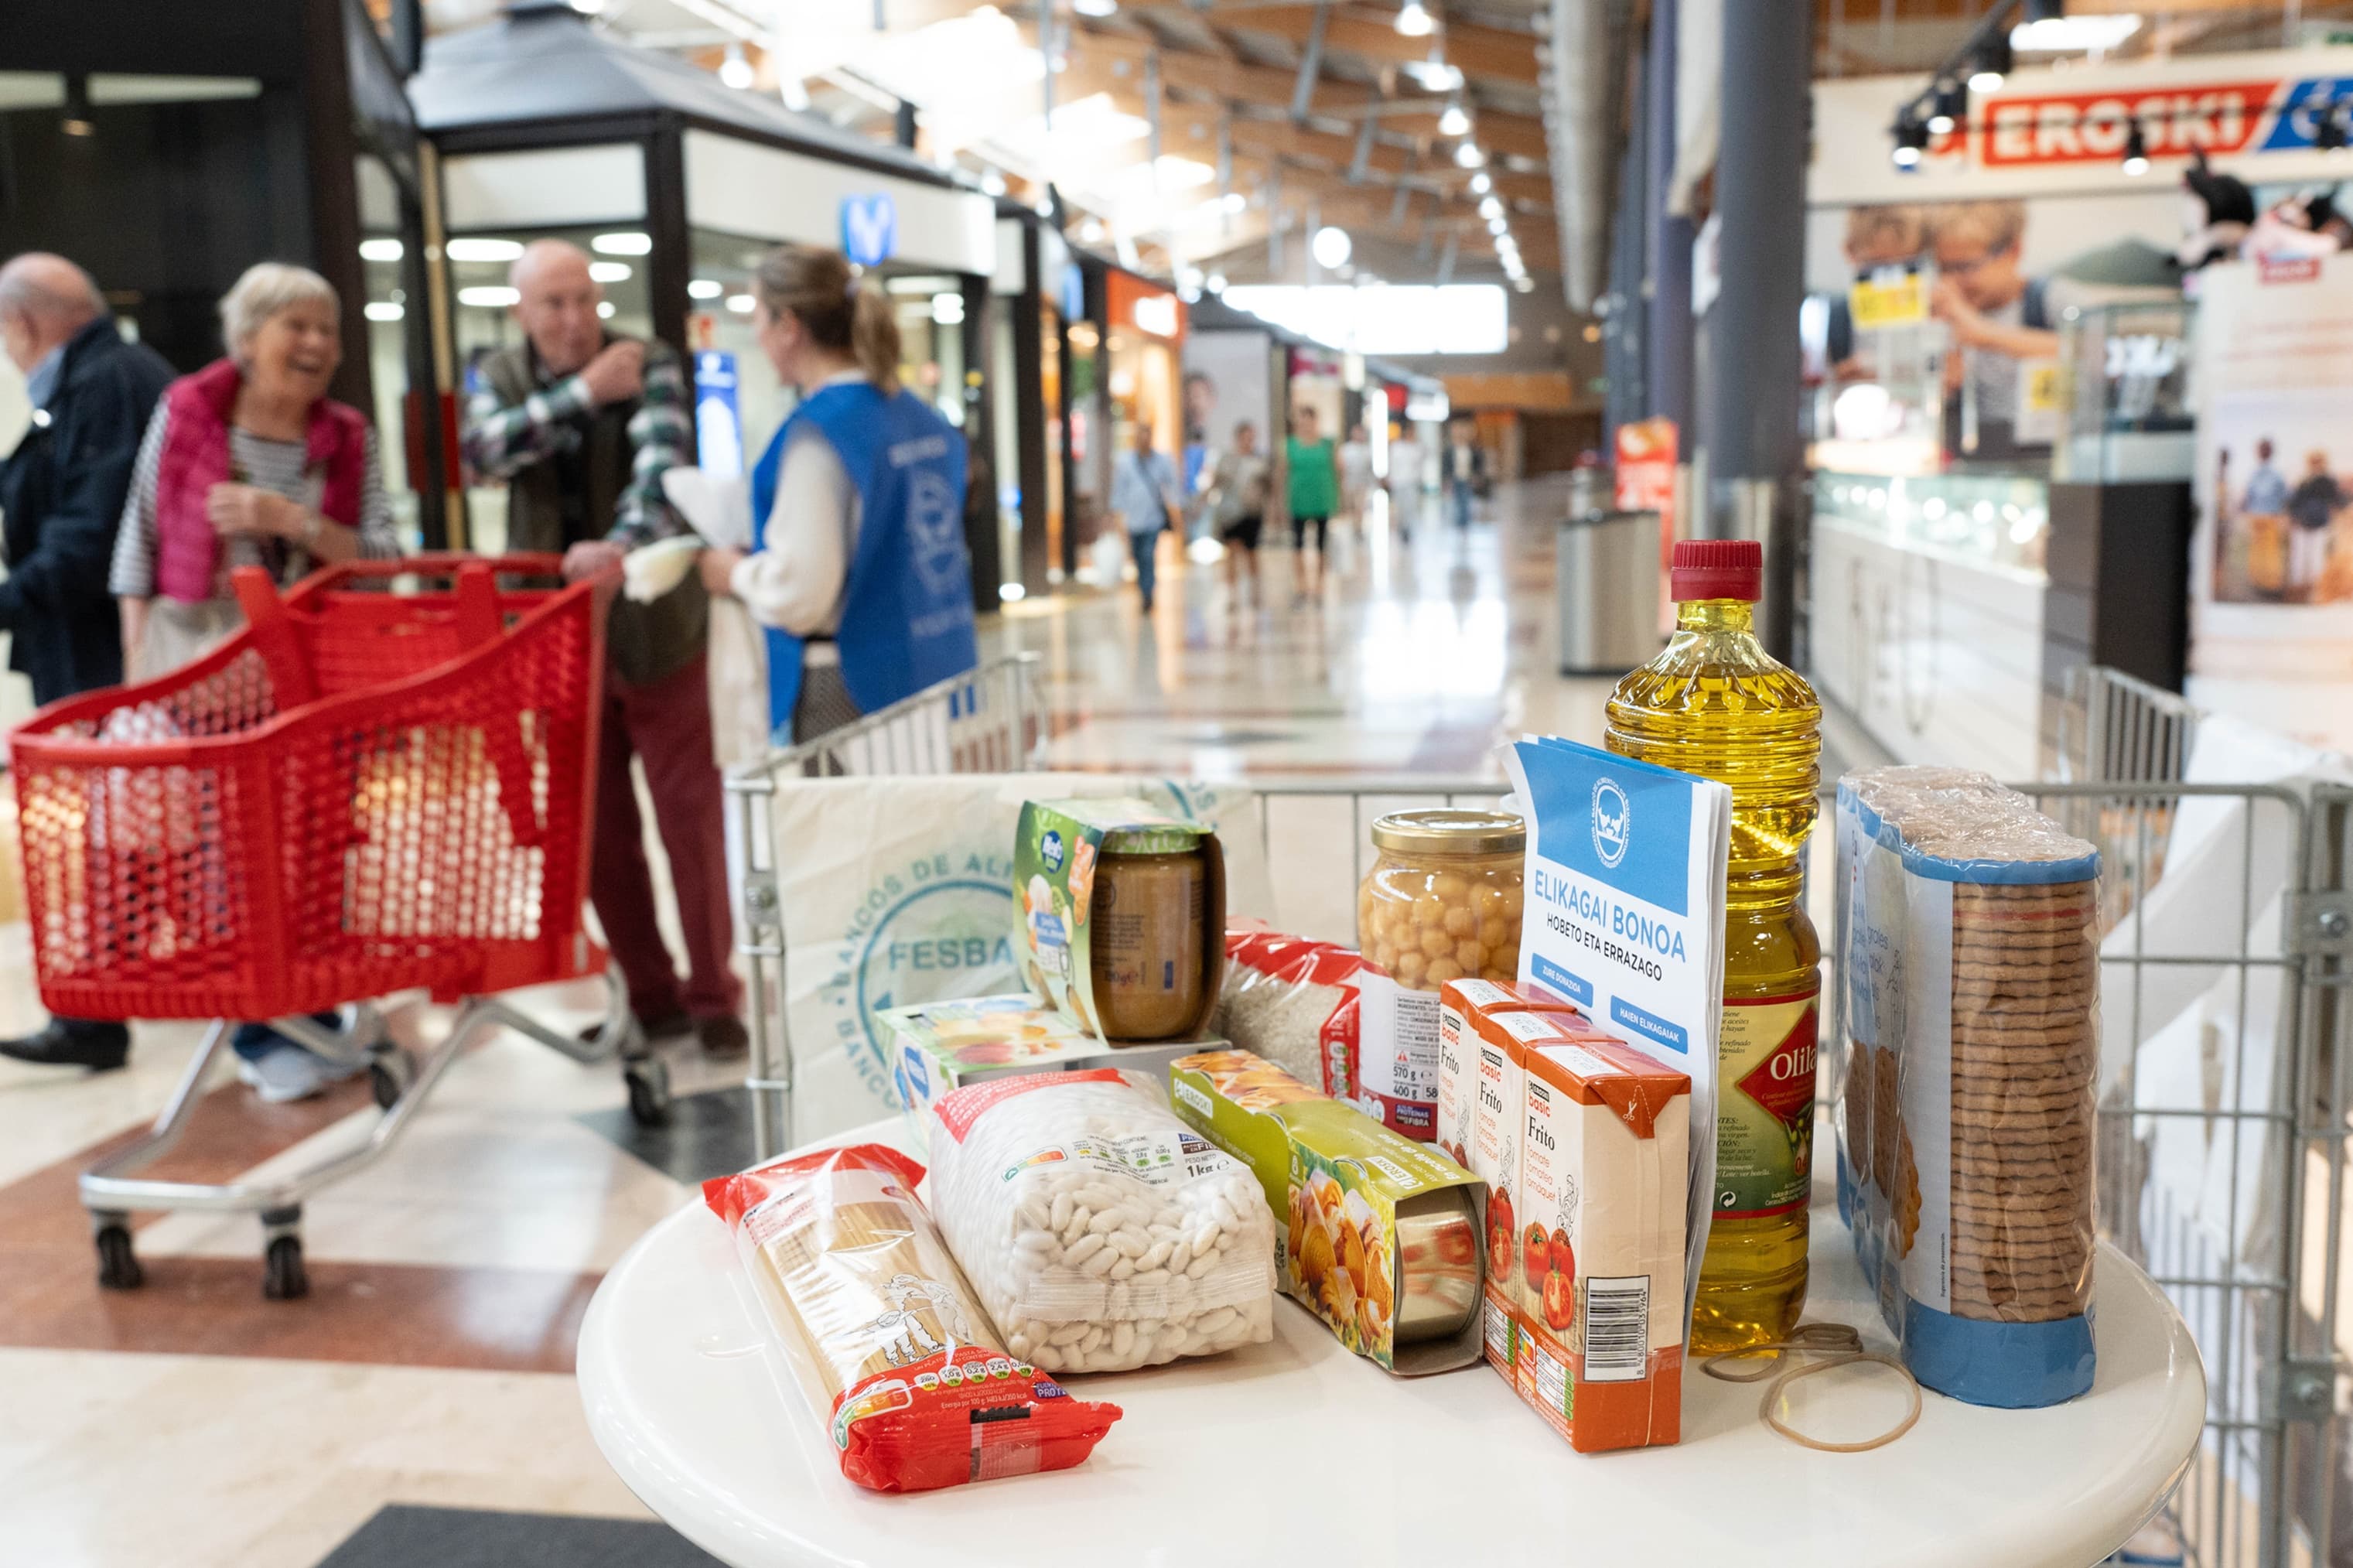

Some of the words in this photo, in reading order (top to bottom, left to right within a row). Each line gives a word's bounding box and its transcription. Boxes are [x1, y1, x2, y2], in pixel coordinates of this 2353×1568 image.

[1993, 91, 2245, 158] EROSKI
[912, 854, 950, 881] DE
[1535, 869, 1607, 928] ELIKAGAI
[1613, 904, 1686, 963] BONOA
[890, 937, 1014, 971] FESBA
[1547, 912, 1582, 943] HOBETO
[1584, 931, 1601, 953] ETA
[1603, 941, 1662, 982] ERRAZAGO
[1542, 965, 1556, 980] ZURE
[1556, 971, 1581, 994] DONAZIOA
[1441, 1023, 1460, 1046] basic
[1620, 1007, 1640, 1025] HAIEN
[1639, 1016, 1680, 1043] ELIKAGAIAK
[1726, 1025, 1746, 1033] hayan
[1440, 1044, 1460, 1075] Frito
[1480, 1058, 1501, 1083] basic
[1770, 1044, 1817, 1081] Olila
[1393, 1066, 1409, 1078] 570
[1410, 1071, 1416, 1081] g
[1185, 1088, 1211, 1114] EROSKI
[1393, 1085, 1409, 1097] 400
[1412, 1089, 1417, 1100] g
[1426, 1087, 1439, 1098] 58
[1480, 1080, 1502, 1114] Frito
[1528, 1094, 1551, 1118] basic
[1528, 1115, 1556, 1151] Frito
[1185, 1156, 1199, 1164] PESO
[1200, 1153, 1217, 1162] NETO
[1197, 1142, 1213, 1151] FI
[1187, 1165, 1195, 1178] 1
[1198, 1163, 1214, 1177] kg
[924, 1357, 945, 1368] PLATO
[956, 1350, 975, 1358] PASTA
[1011, 1361, 1027, 1370] 0,0
[1038, 1388, 1066, 1398] PROT
